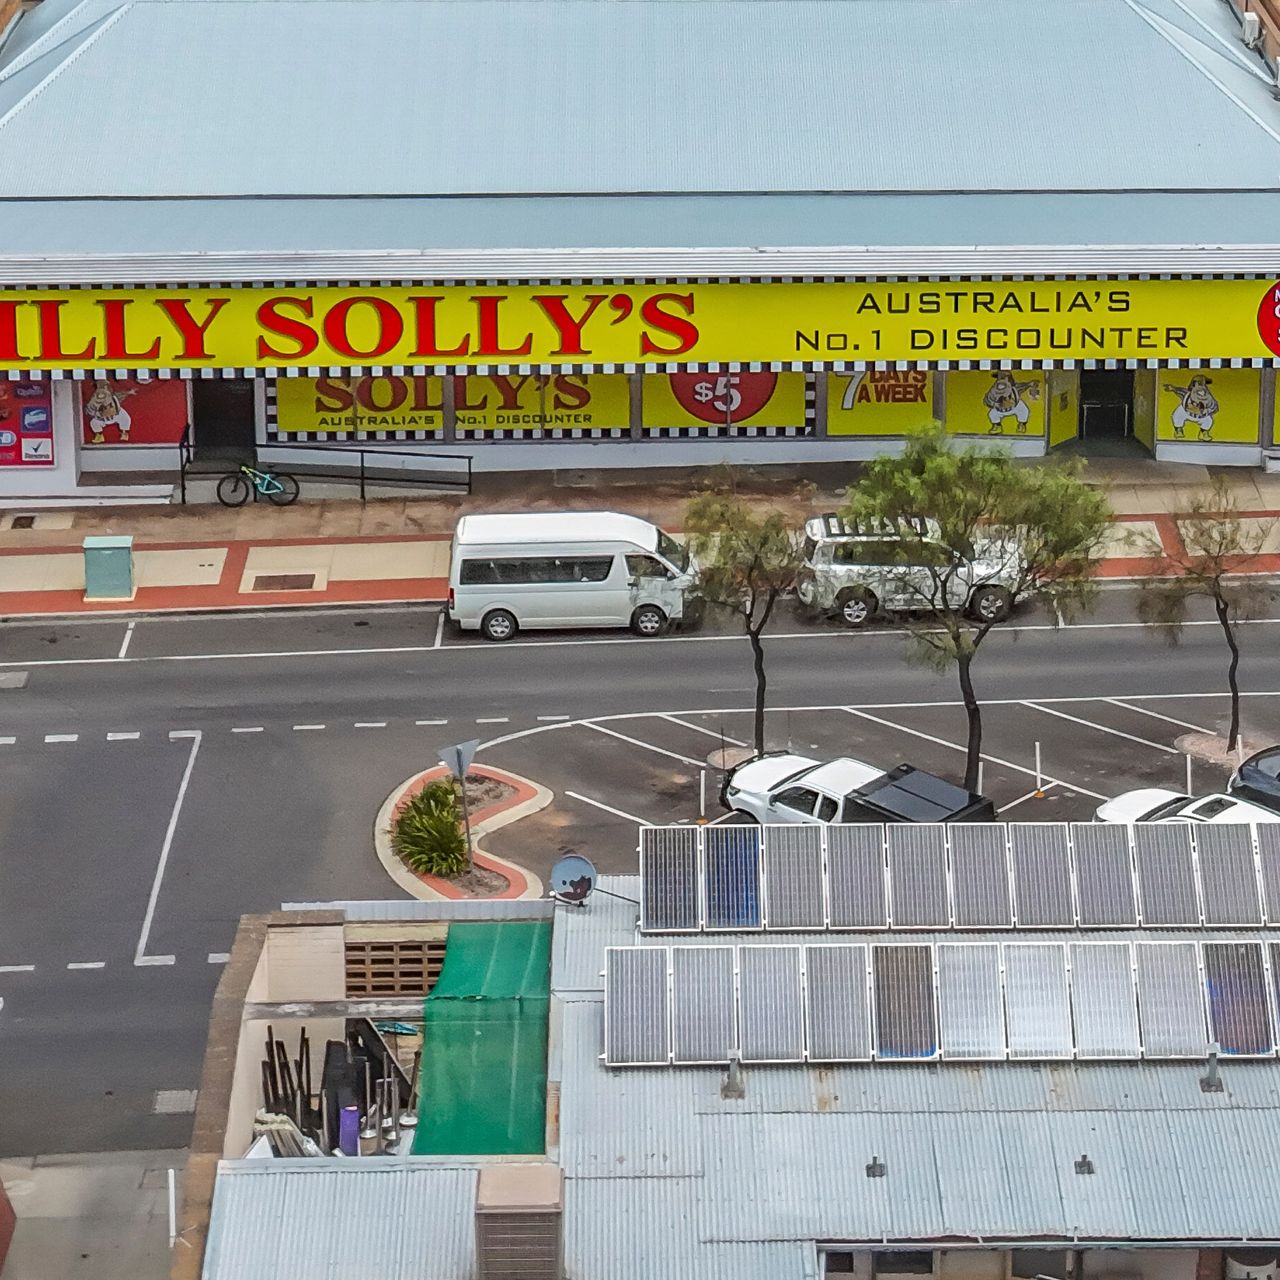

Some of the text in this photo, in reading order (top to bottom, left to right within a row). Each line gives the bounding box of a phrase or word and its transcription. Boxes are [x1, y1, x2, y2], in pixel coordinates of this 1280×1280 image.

[857, 291, 1131, 314] AUSTRALIA'S
[256, 292, 701, 360] SOLLY'S
[794, 326, 1190, 353] No.1 DISCOUNTER
[314, 374, 592, 413] SOLLY'S
[693, 376, 742, 413] $5
[834, 370, 927, 411] 7 DAYS
[857, 383, 927, 403] A WEEK
[318, 413, 593, 426] AUSTRALIA'S No.1 DISCOUNTER
